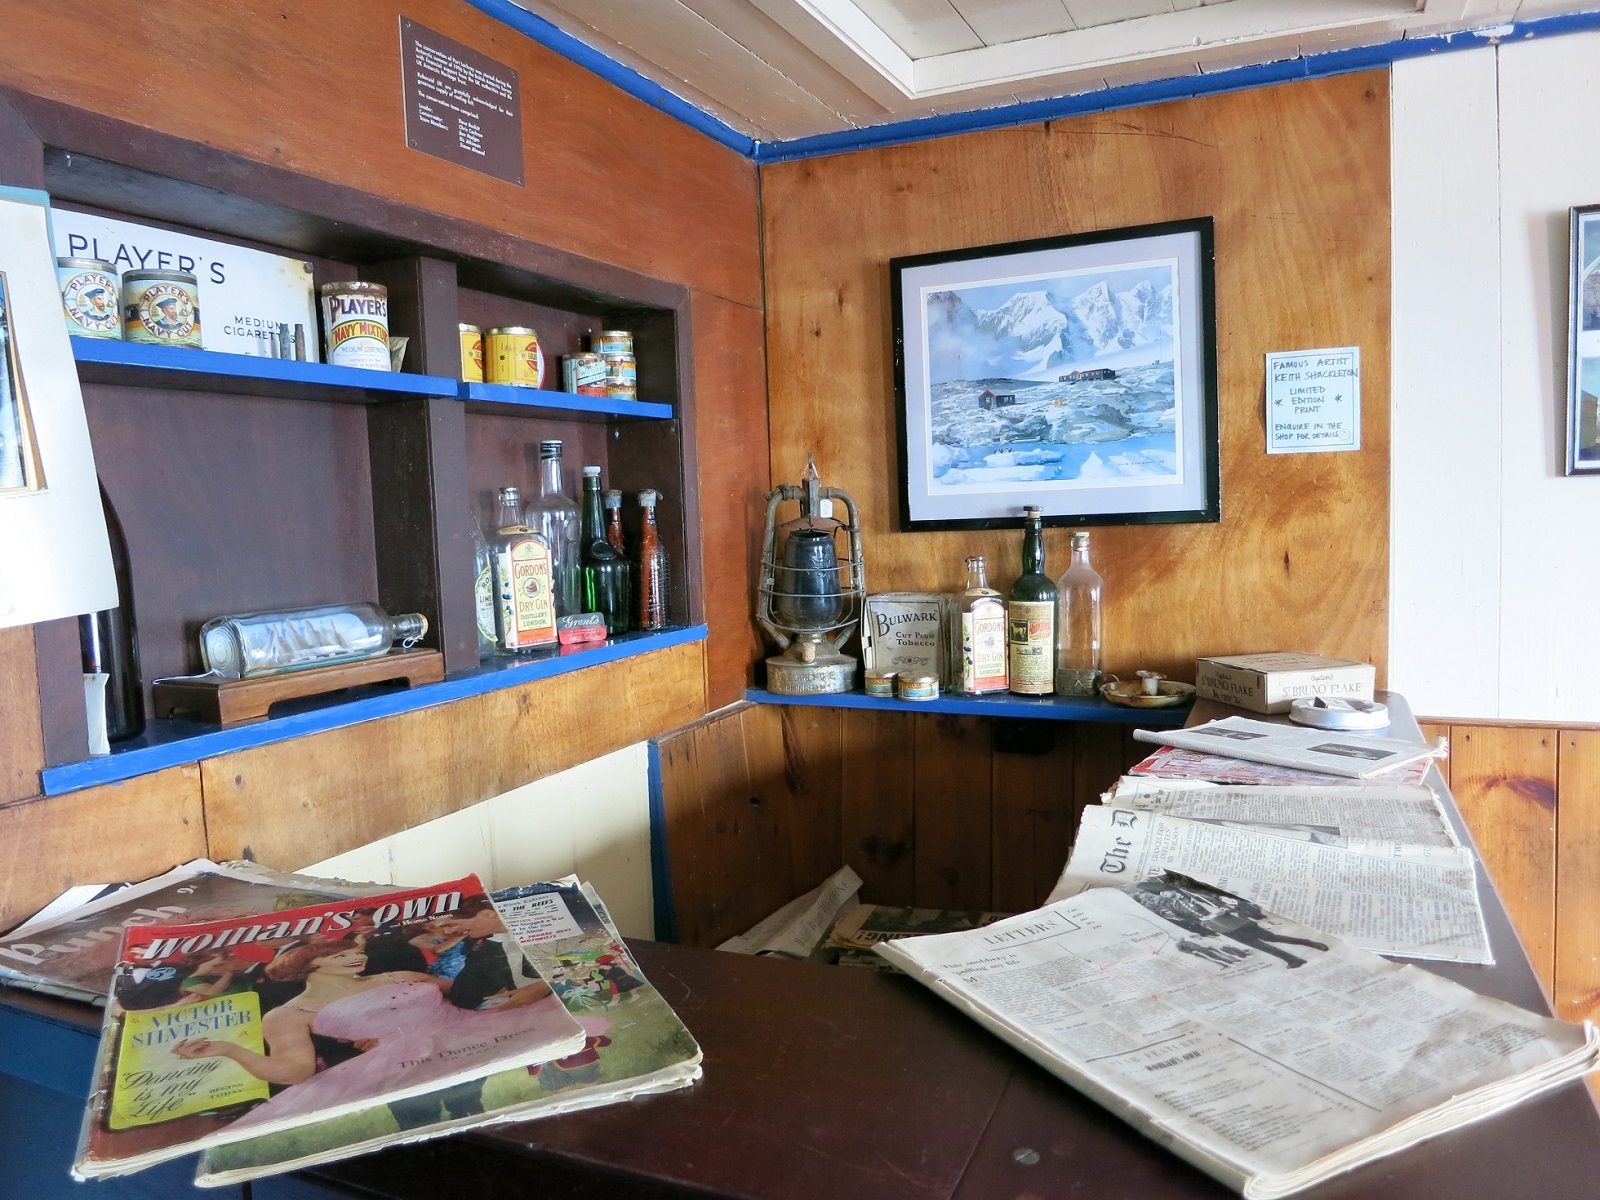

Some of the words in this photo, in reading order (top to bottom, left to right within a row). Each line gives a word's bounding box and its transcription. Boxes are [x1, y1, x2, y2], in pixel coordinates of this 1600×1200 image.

[143, 285, 190, 305] PLAYER'S
[328, 295, 387, 326] PLAYER'S
[69, 308, 101, 330] NAVY
[143, 318, 172, 338] NAVY
[177, 321, 193, 337] CUT
[1273, 360, 1309, 370] FAMOUS
[1317, 358, 1350, 367] ARTIST
[1275, 372, 1301, 383] KEITH
[1304, 368, 1359, 380] SHACKLETON
[1290, 386, 1326, 395] LIMITED
[1292, 396, 1325, 405] EDITION
[1294, 406, 1321, 414] PRINT
[1275, 422, 1310, 431] ENQUIRE
[1275, 432, 1294, 440] SHOP
[1297, 432, 1310, 440] FOR
[1312, 431, 1340, 439] DETAILS
[519, 601, 534, 613] DRY
[535, 598, 548, 610] GIN
[562, 615, 600, 628] Grant's
[896, 638, 935, 647] Tobacco
[977, 653, 991, 663] DRY
[992, 651, 1004, 661] GIN
[1207, 677, 1229, 690] BRUNO
[1230, 683, 1253, 697] FLAKE
[1293, 684, 1327, 696] BRUNO
[531, 899, 554, 908] REEFS
[402, 917, 428, 926] Home
[429, 913, 454, 921] Notes
[984, 919, 1059, 945] LETTERS
[152, 999, 233, 1028] VICTOR
[131, 1010, 252, 1048] SILVESTER
[397, 1057, 432, 1069] This
[438, 1041, 488, 1058] Dance
[494, 1027, 536, 1043] Dress
[133, 1087, 153, 1102] is
[161, 1078, 203, 1097] my
[209, 1083, 244, 1094] BEGINS
[210, 1089, 244, 1099] TODAY
